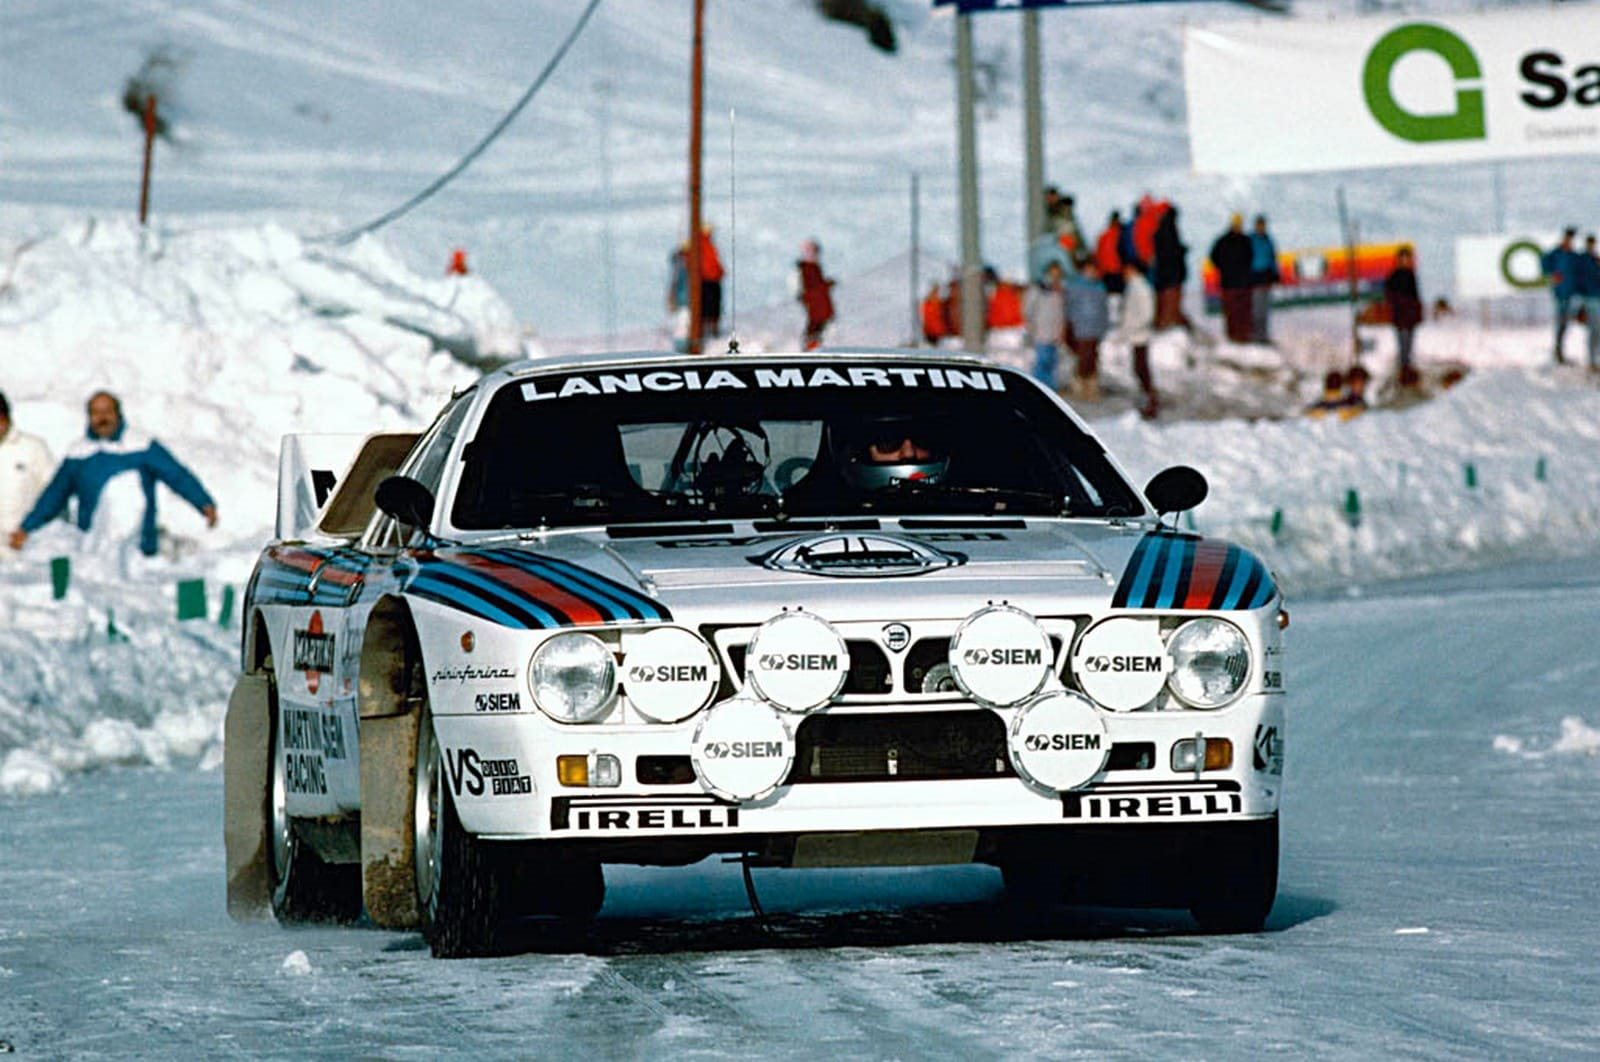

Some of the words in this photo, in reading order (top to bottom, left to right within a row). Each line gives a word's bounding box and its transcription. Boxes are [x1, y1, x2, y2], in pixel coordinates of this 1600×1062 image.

[520, 370, 747, 402] LANCIA
[753, 367, 1007, 392] MARTINI
[787, 654, 838, 671] SIEM
[992, 648, 1042, 665] SIEM
[1112, 655, 1162, 673] SIEM
[657, 665, 708, 682] SIEM
[488, 694, 520, 711] SIEM
[732, 741, 784, 758] SIEM
[1051, 734, 1101, 751] SIEM
[286, 753, 328, 795] RACING
[446, 747, 485, 796] VS
[481, 760, 519, 777] OLIO
[493, 776, 532, 795] FIAT
[1061, 779, 1242, 818] PIRELLI
[551, 794, 741, 830] PIRELLI
